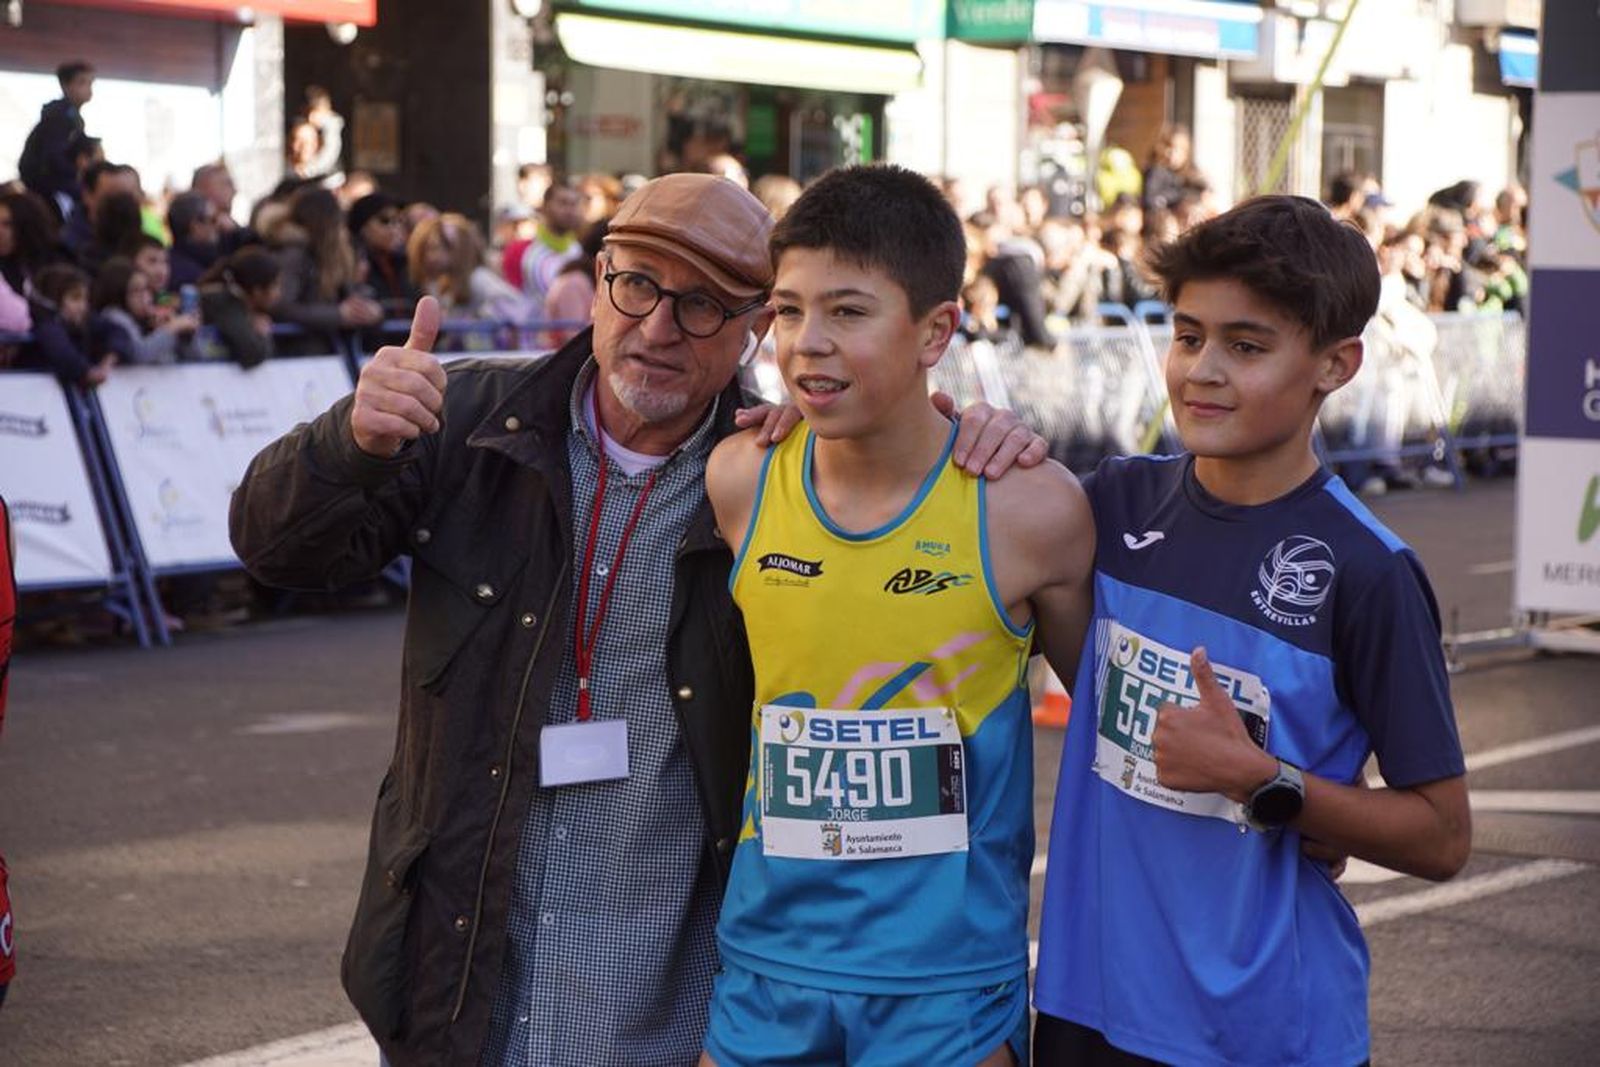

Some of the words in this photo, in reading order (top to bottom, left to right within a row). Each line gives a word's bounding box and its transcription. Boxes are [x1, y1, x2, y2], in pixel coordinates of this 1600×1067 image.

[1250, 590, 1317, 626] ENTREVILLAS
[809, 717, 940, 742] SETEL
[787, 747, 912, 808] 5490
[827, 808, 869, 821] JORGE
[846, 833, 903, 843] Ayuntamiento
[846, 846, 856, 855] de
[859, 844, 903, 854] Salamanca
